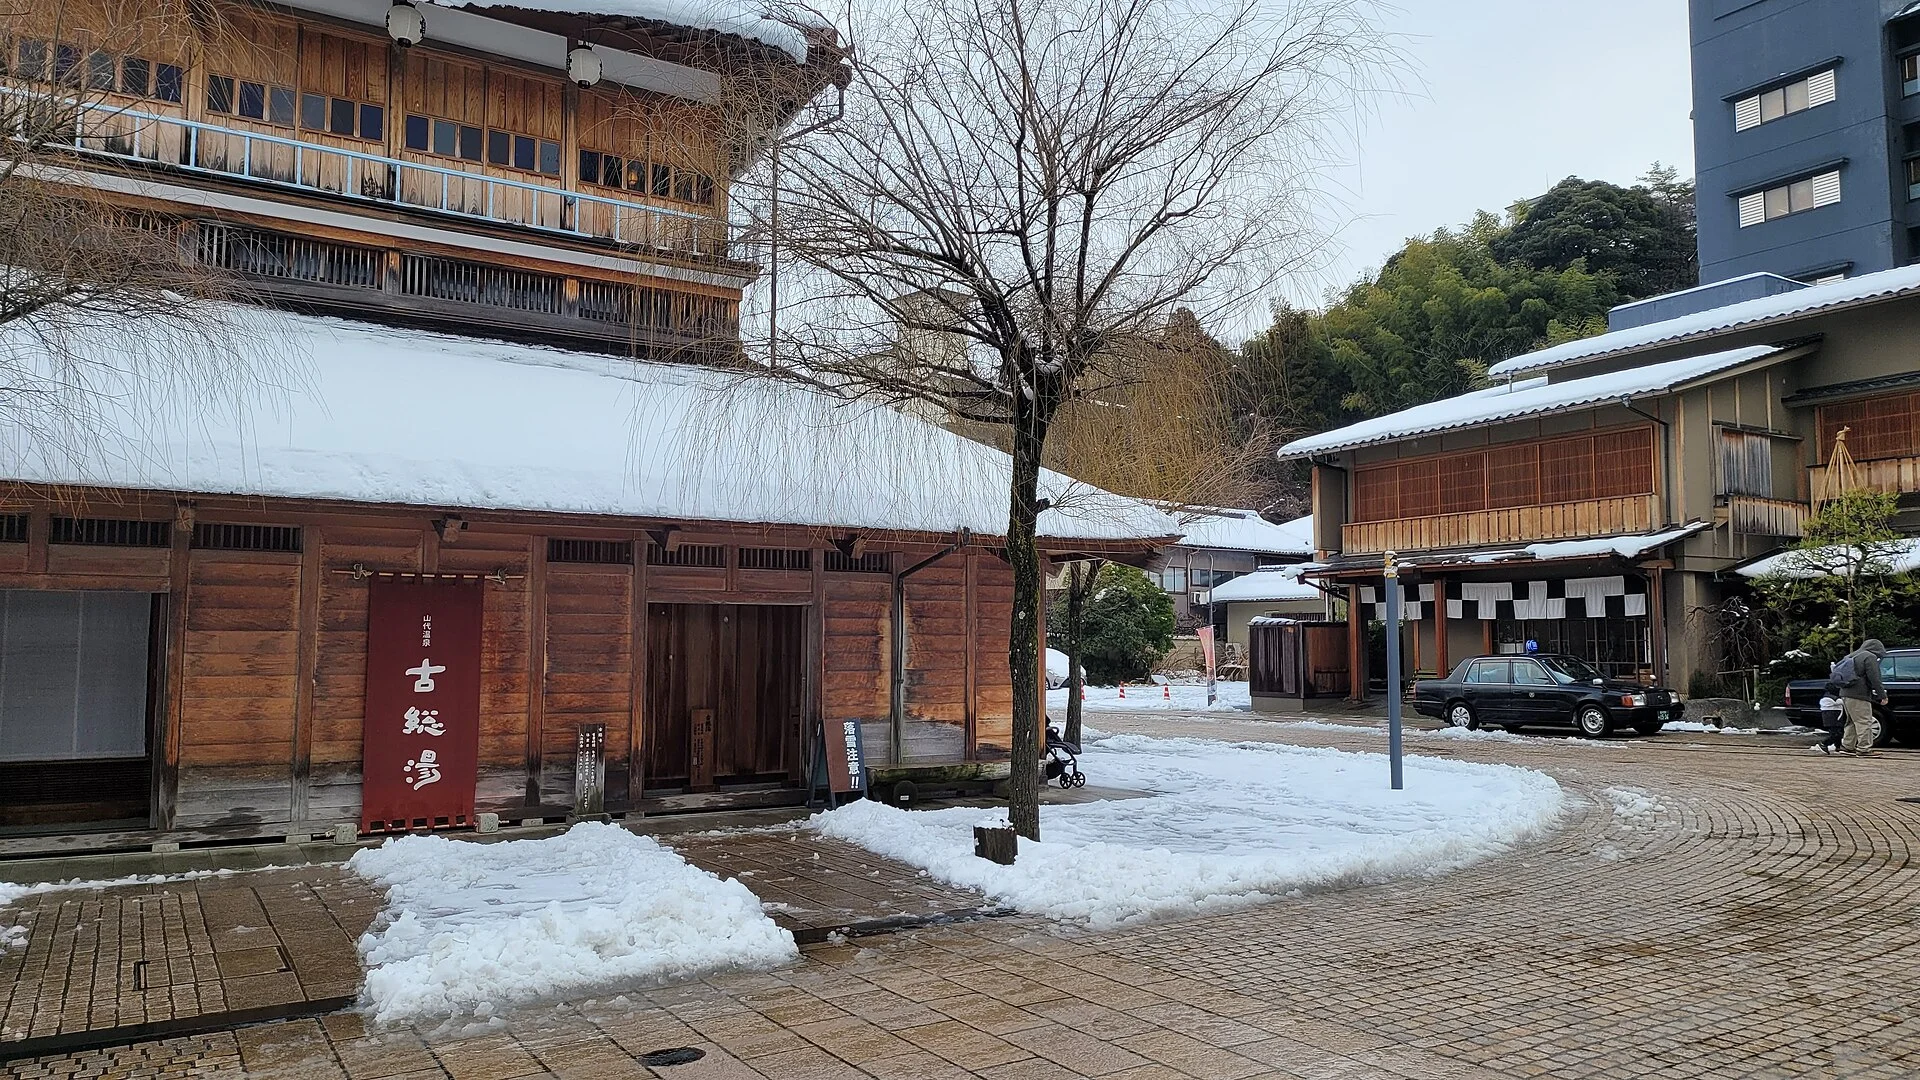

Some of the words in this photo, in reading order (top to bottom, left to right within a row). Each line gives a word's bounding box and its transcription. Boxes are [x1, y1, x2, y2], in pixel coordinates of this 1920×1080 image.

[422, 614, 432, 647] 山代温泉
[402, 658, 447, 791] 古総湯
